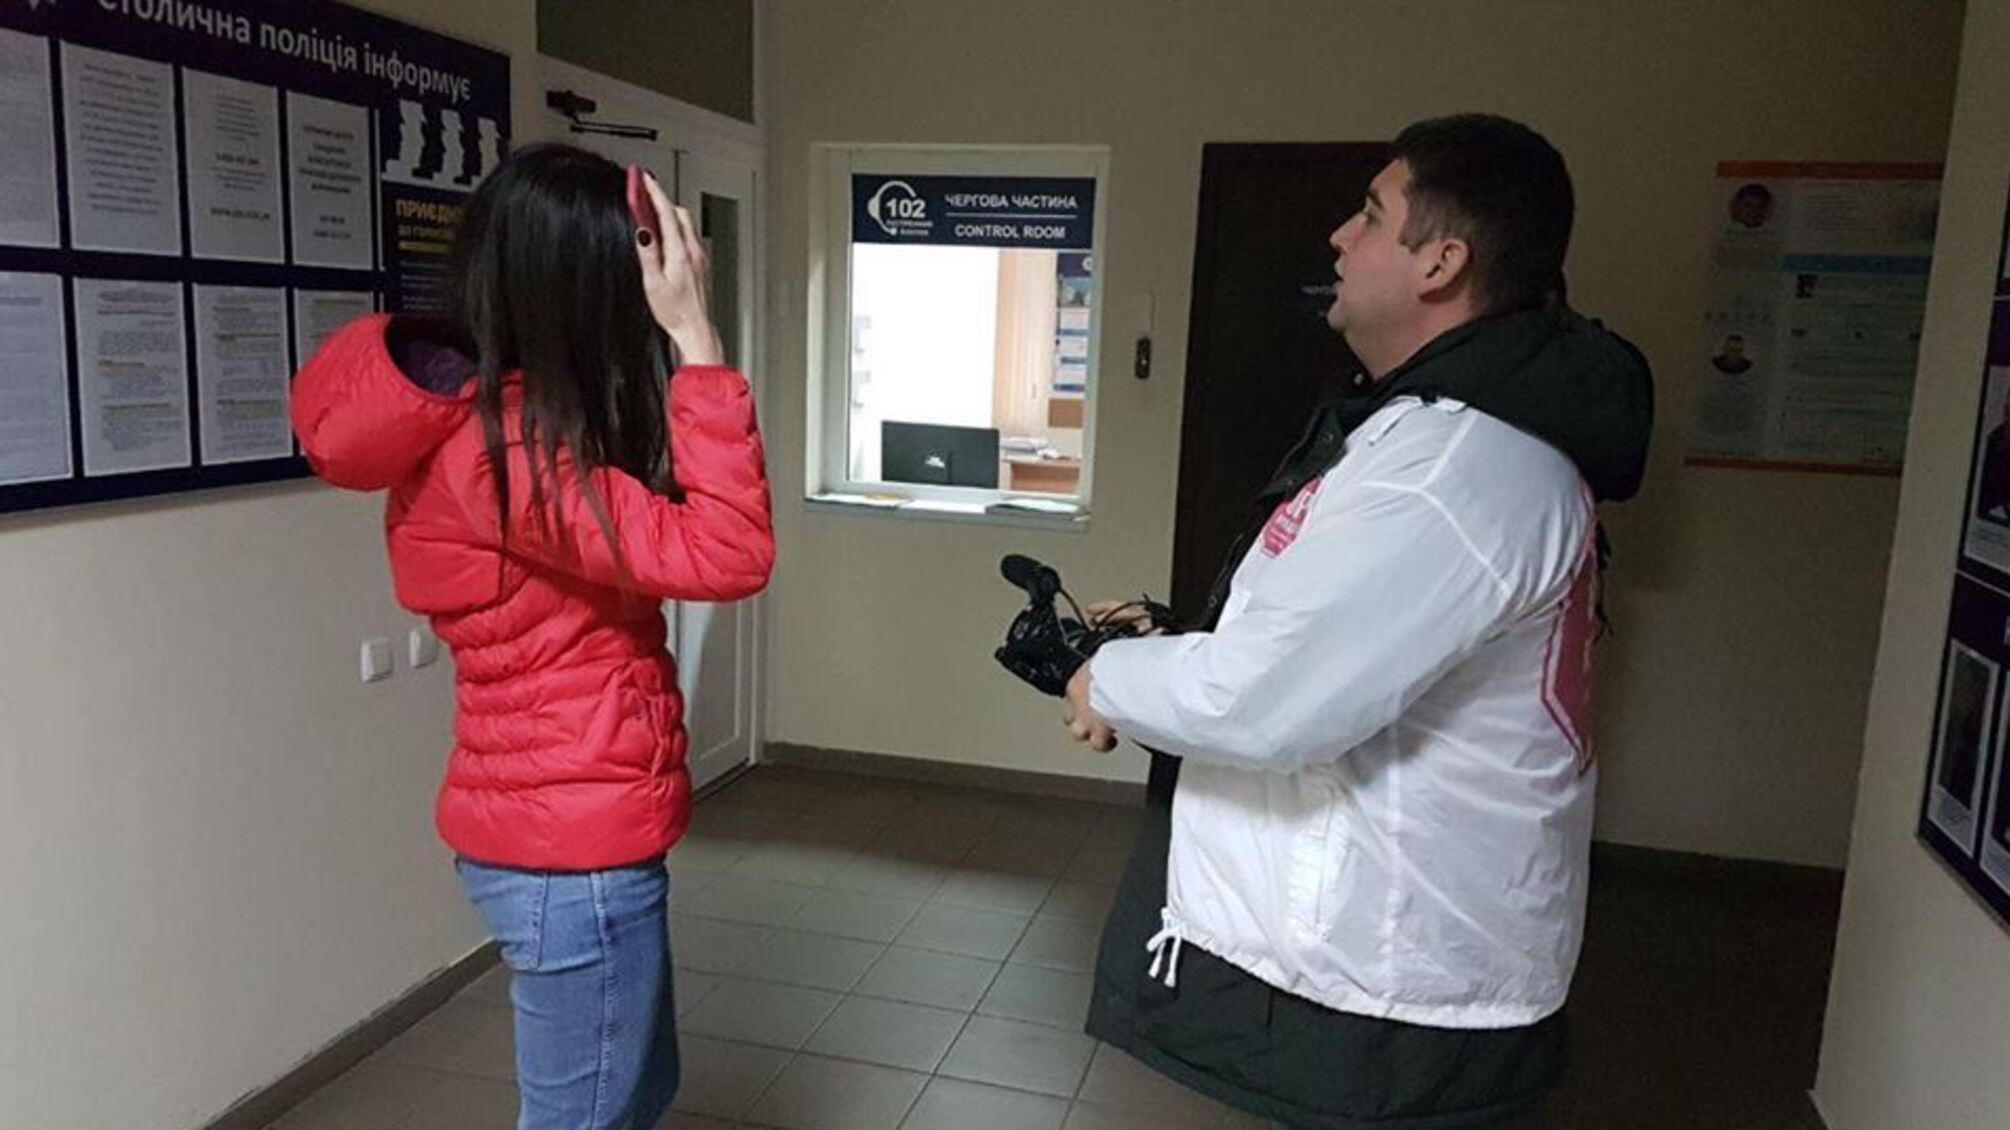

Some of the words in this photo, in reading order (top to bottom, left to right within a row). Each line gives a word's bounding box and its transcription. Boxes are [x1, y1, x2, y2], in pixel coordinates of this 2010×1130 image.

[260, 23, 358, 72] поліція
[365, 43, 471, 102] інформує
[885, 198, 926, 218] 102
[945, 194, 1008, 208] ЧЕРГОВА
[1012, 195, 1078, 209] ЧАСТИНА
[954, 224, 1019, 238] CONTROL
[1023, 226, 1067, 239] ROOM
